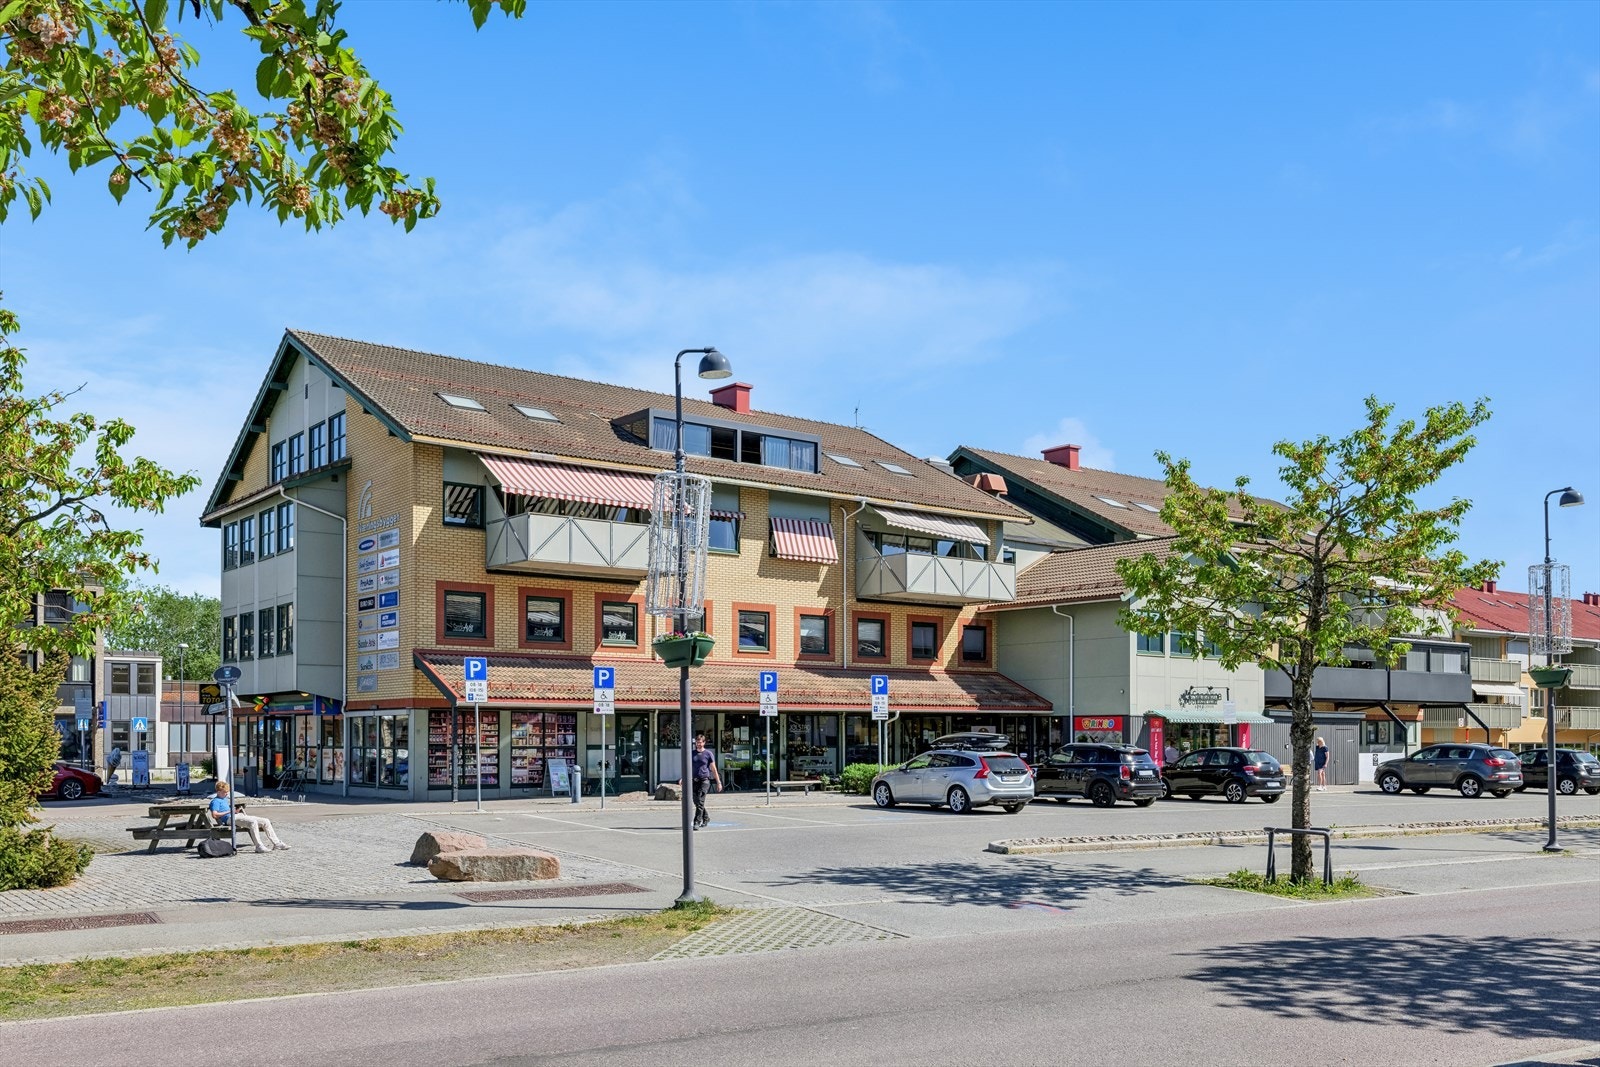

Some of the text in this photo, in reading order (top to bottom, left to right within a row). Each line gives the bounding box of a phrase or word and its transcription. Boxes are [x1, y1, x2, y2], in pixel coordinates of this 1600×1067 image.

[470, 660, 481, 678] P
[598, 670, 610, 686] P
[764, 674, 774, 690] P
[875, 677, 885, 693] P
